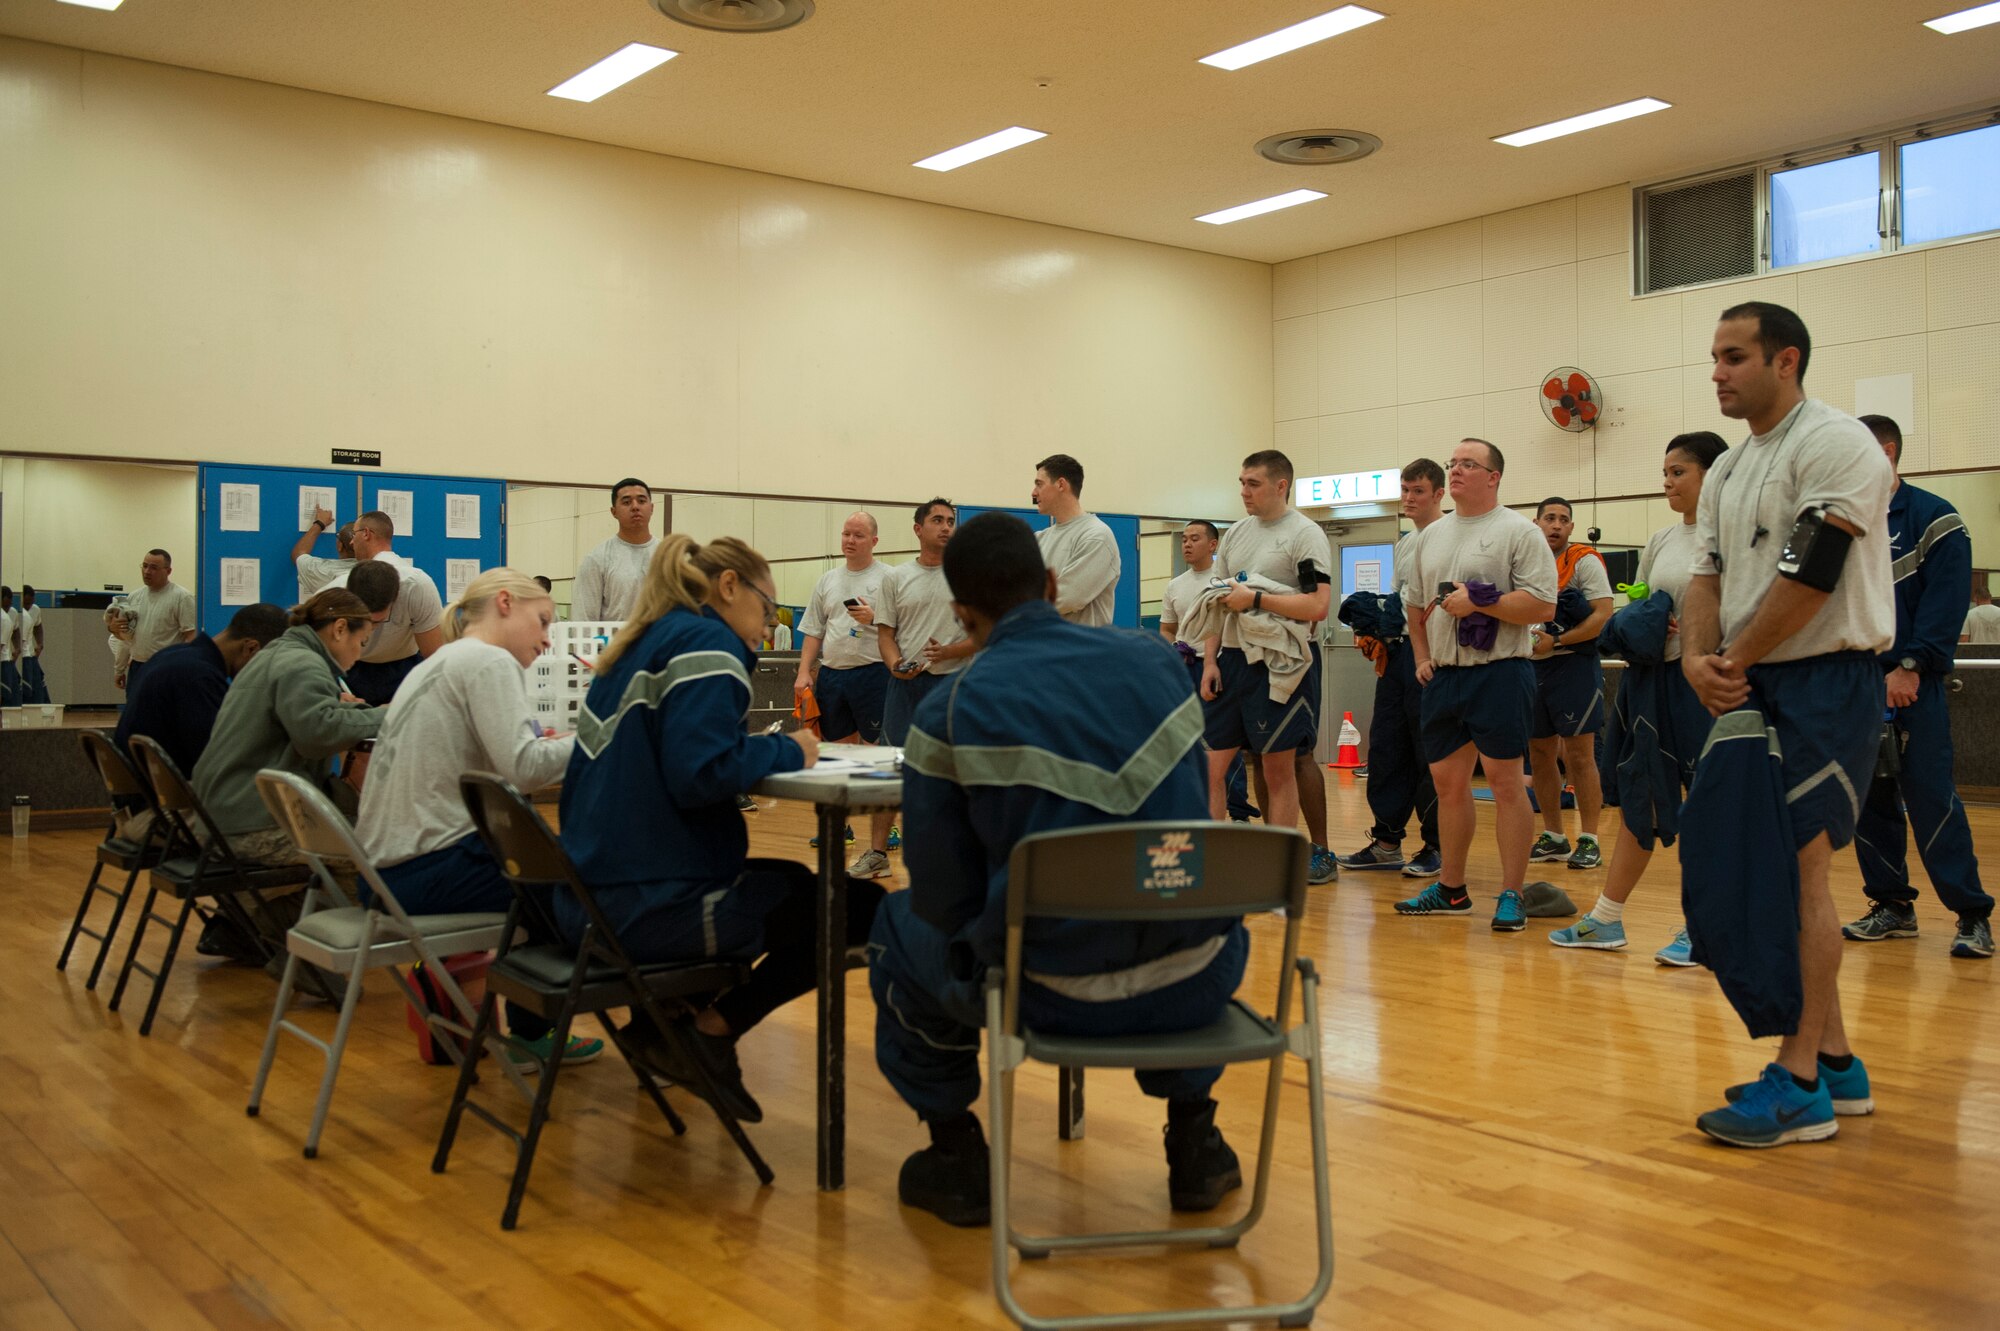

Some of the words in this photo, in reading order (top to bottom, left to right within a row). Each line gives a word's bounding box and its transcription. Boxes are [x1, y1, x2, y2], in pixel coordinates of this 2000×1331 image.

[333, 450, 360, 458] STORAGE
[1312, 474, 1383, 501] EXIT
[1153, 868, 1186, 880] FOR
[1143, 876, 1196, 889] EVENT
